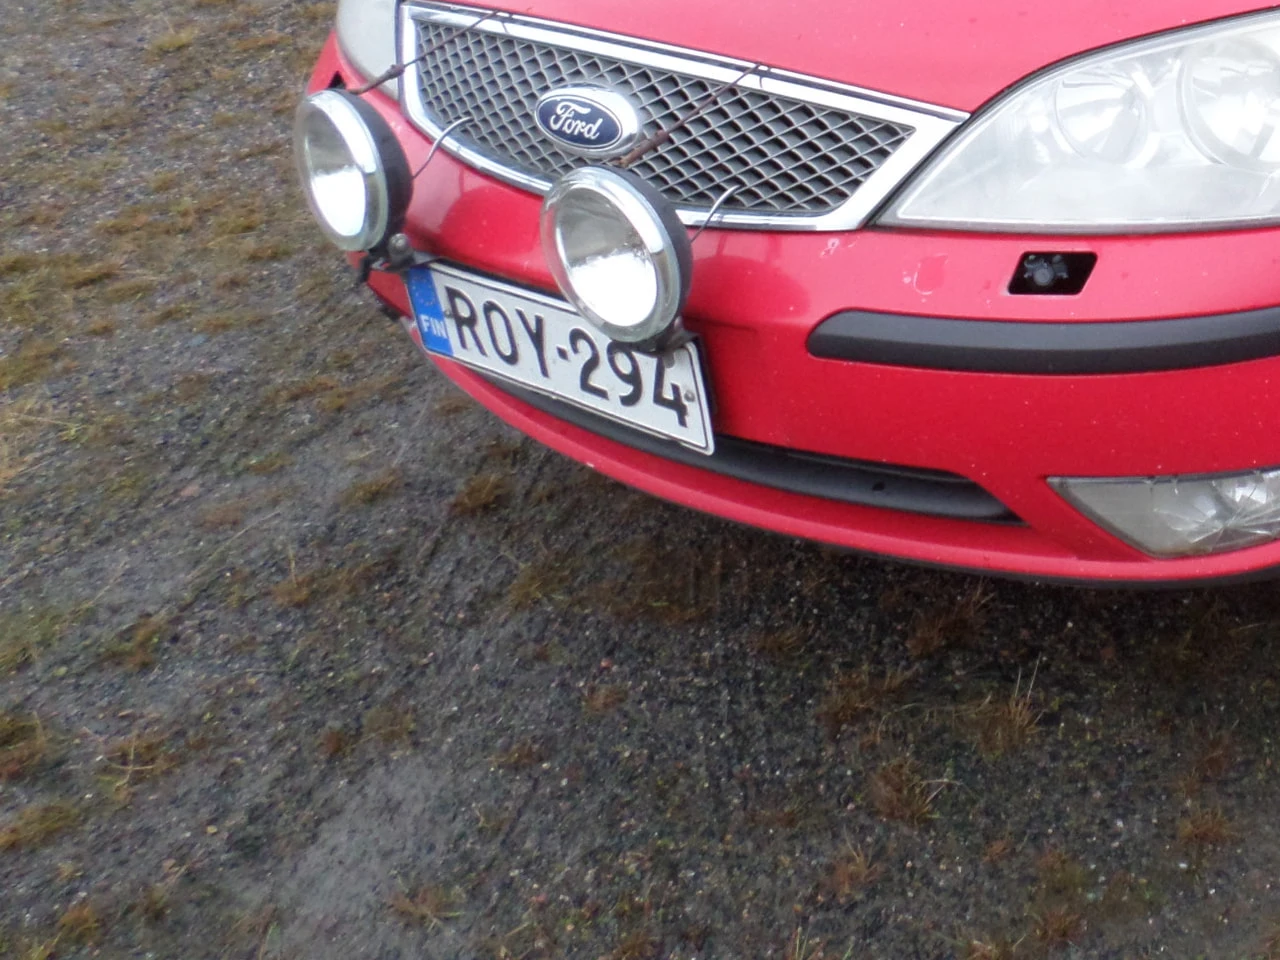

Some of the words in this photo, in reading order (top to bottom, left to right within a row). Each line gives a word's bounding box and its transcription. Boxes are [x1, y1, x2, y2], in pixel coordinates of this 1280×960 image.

[549, 101, 604, 140] Ford
[420, 314, 448, 339] FIN
[444, 286, 689, 429] ROY-294
